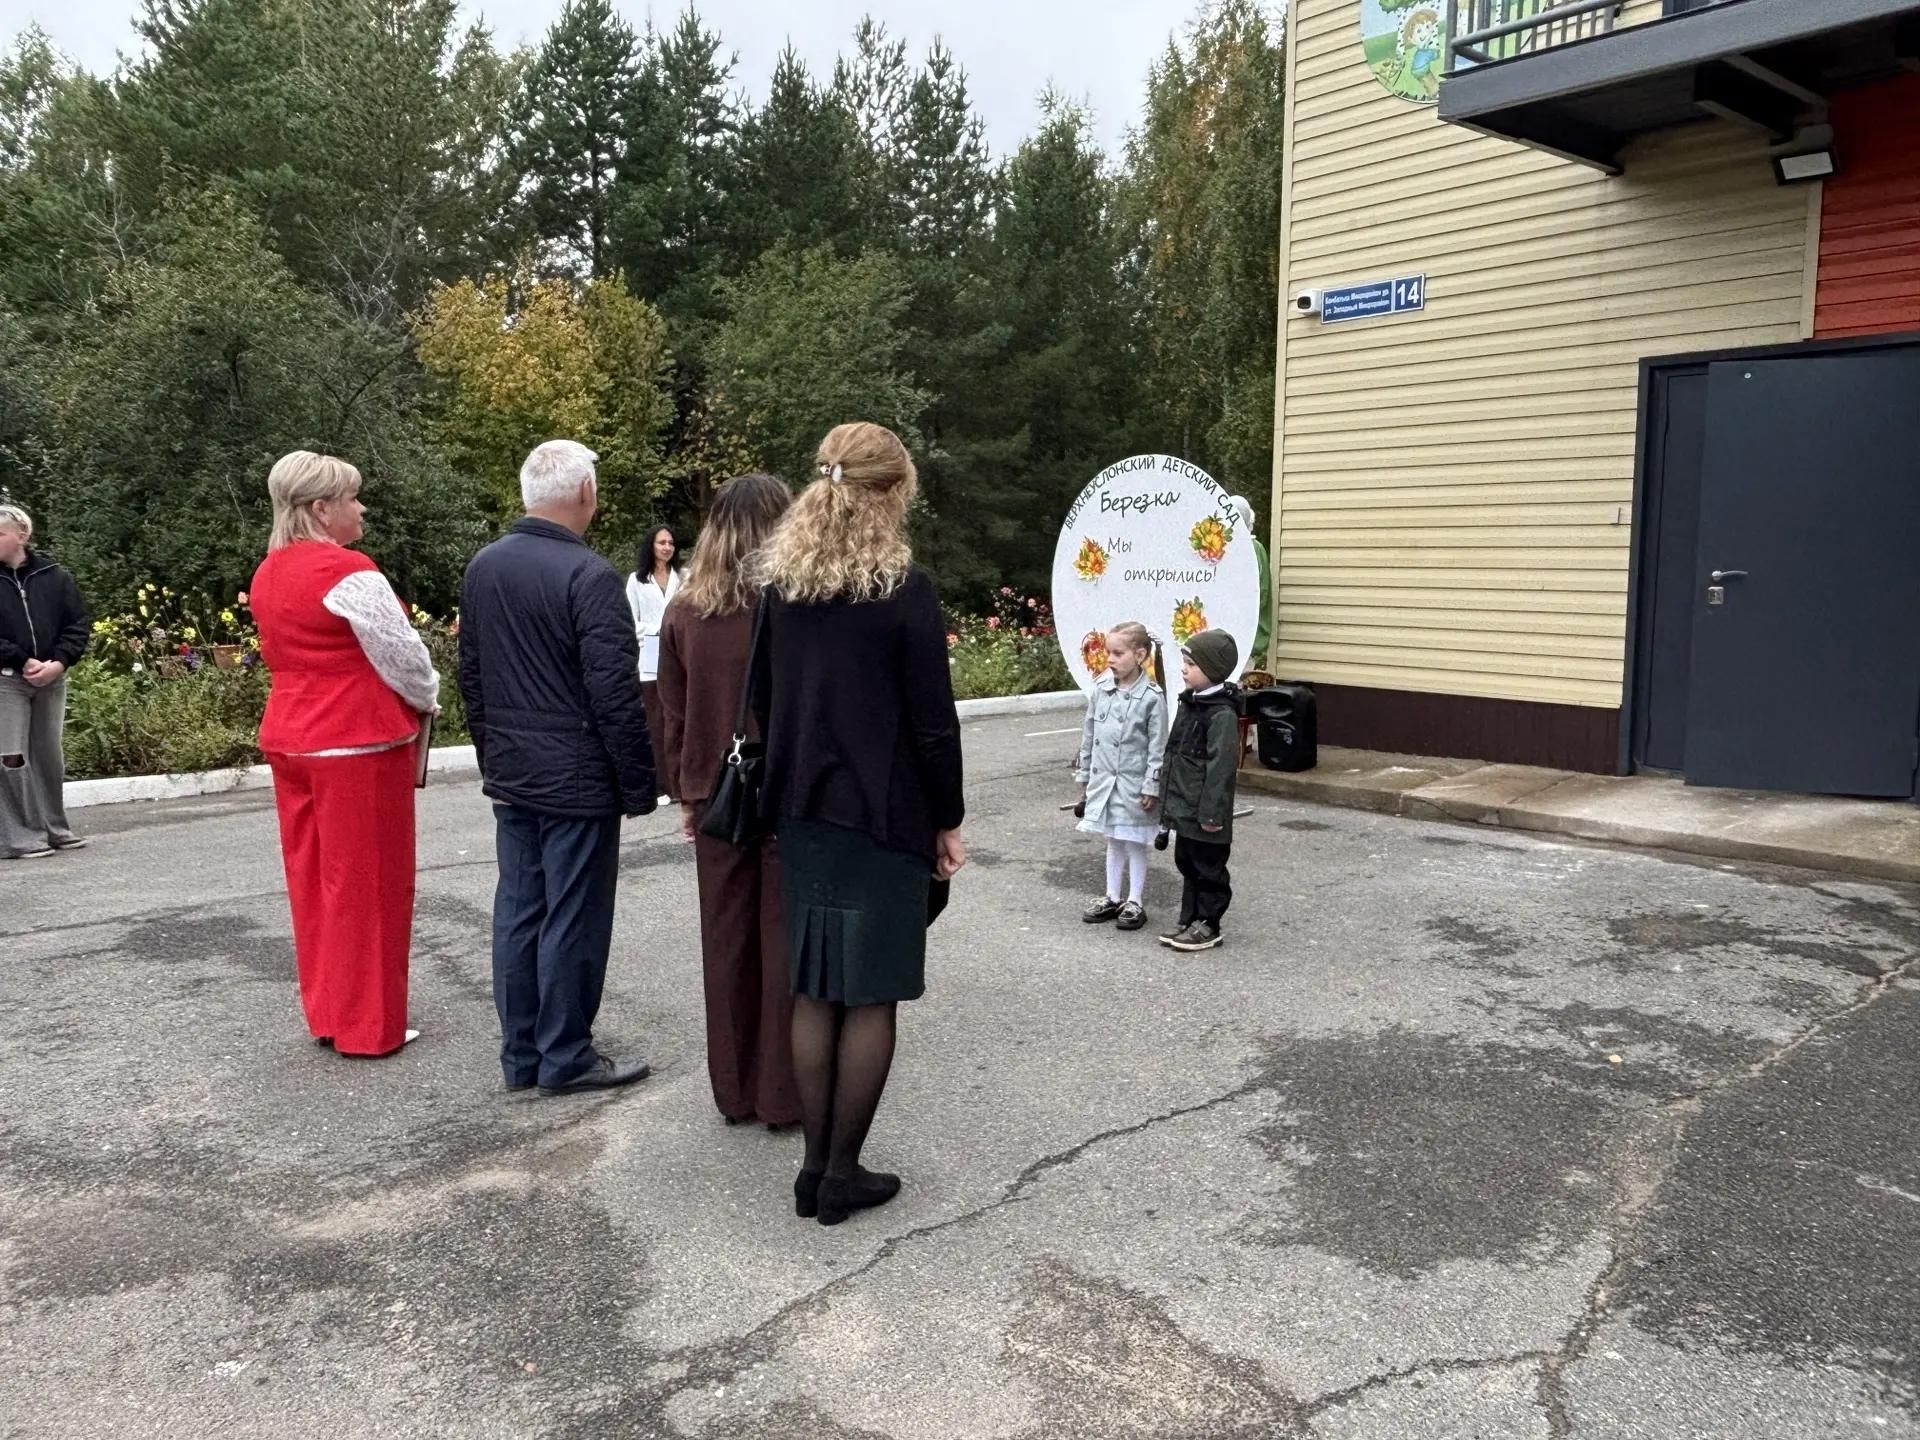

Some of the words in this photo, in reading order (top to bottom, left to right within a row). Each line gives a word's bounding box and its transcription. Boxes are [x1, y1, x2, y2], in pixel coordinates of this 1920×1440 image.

[1397, 281, 1420, 306] 14
[1064, 456, 1155, 530] ВЕРХНЕУСЛОНСКИЙ
[1162, 457, 1218, 495] ДЕТСКИЙ
[1217, 494, 1241, 527] САД
[1100, 490, 1181, 518] Березка
[1107, 537, 1132, 553] Мы
[1124, 566, 1217, 587] открылись!
